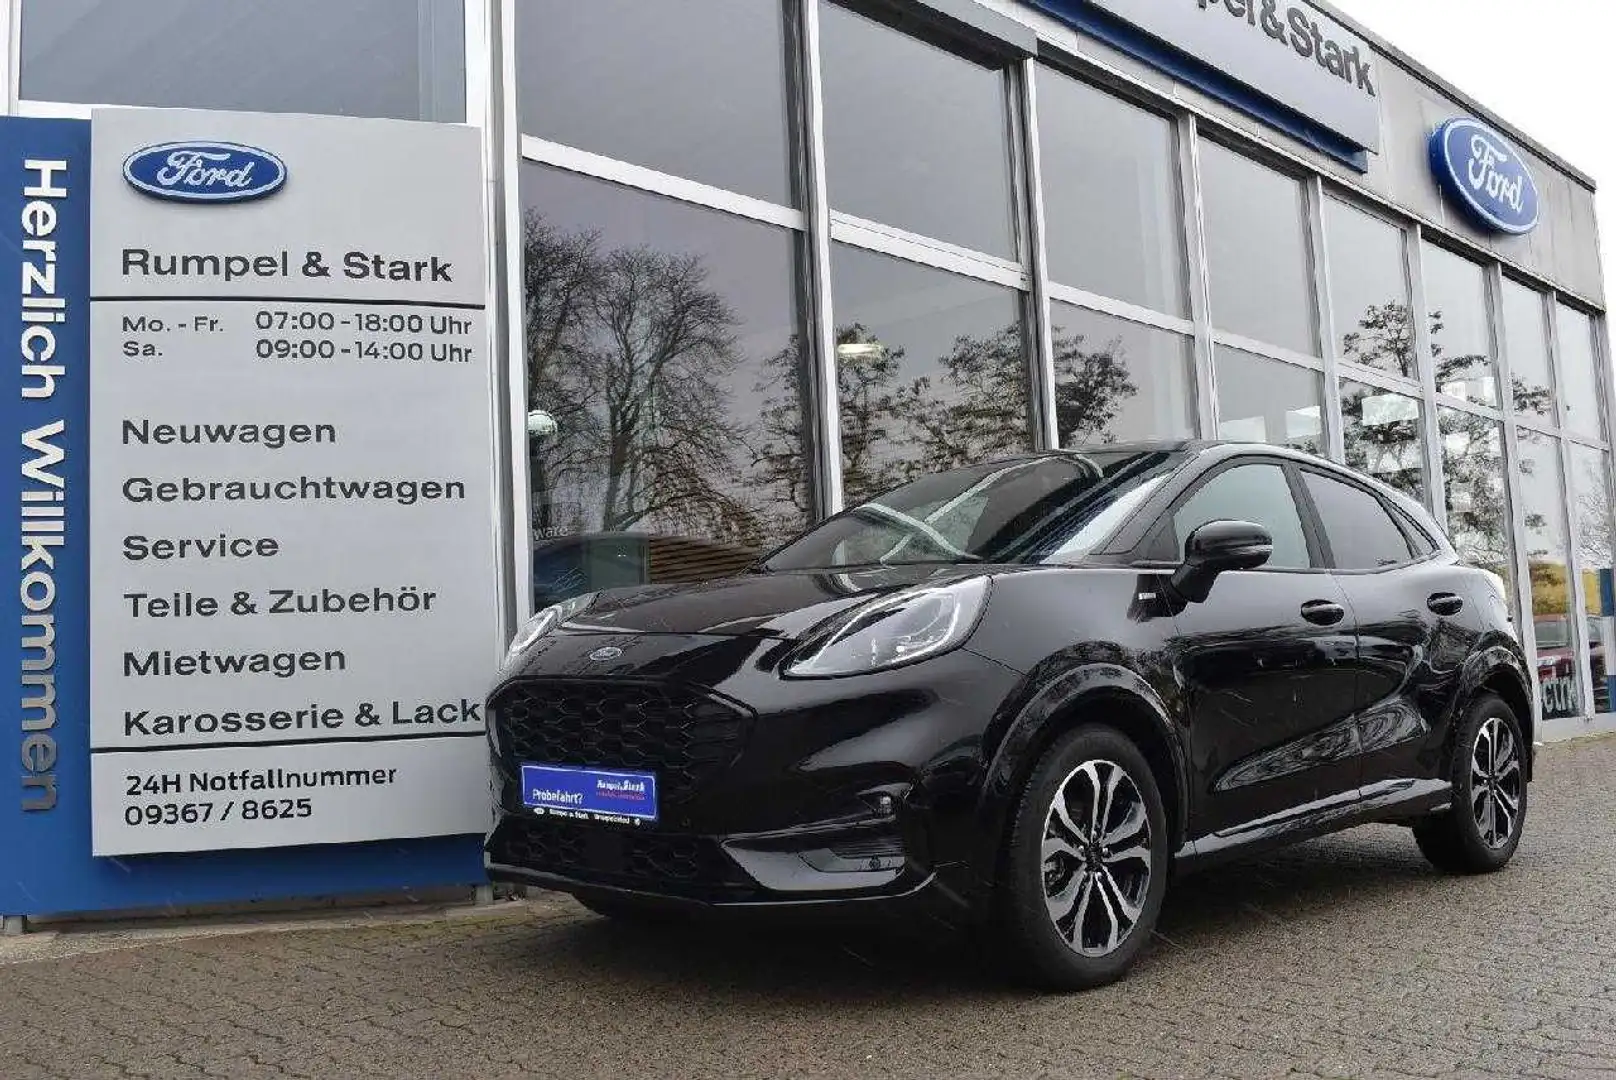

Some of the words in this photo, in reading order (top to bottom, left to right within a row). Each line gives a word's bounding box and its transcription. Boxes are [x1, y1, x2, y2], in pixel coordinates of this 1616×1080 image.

[156, 150, 255, 187] Ford
[1468, 134, 1525, 213] Ford
[21, 159, 67, 399] Herzlich
[122, 248, 289, 282] Rumpel
[301, 251, 331, 279] &
[343, 251, 453, 283] Stark
[122, 316, 170, 333] Mo.
[194, 315, 224, 333] Fr.
[430, 315, 473, 335] Uhr
[122, 340, 163, 358] Sa.
[430, 343, 473, 363] Uhr
[122, 419, 337, 449] Neuwagen
[122, 476, 466, 505] Gebrauchtwagen
[122, 533, 280, 561] Service
[20, 419, 66, 812] Willkommen
[123, 592, 219, 618] Teile
[231, 591, 259, 616] &
[268, 586, 438, 615] Zubehör
[123, 649, 347, 679] Mietwagen
[124, 703, 345, 738] Karosserie
[354, 702, 383, 728] &
[392, 698, 483, 726] Lack
[126, 773, 182, 796] 24H
[189, 767, 398, 794] Notfallnummer
[532, 788, 584, 805] Probefahrt?
[125, 802, 214, 827] 09367
[219, 801, 236, 822] /
[241, 797, 313, 821] 8625
